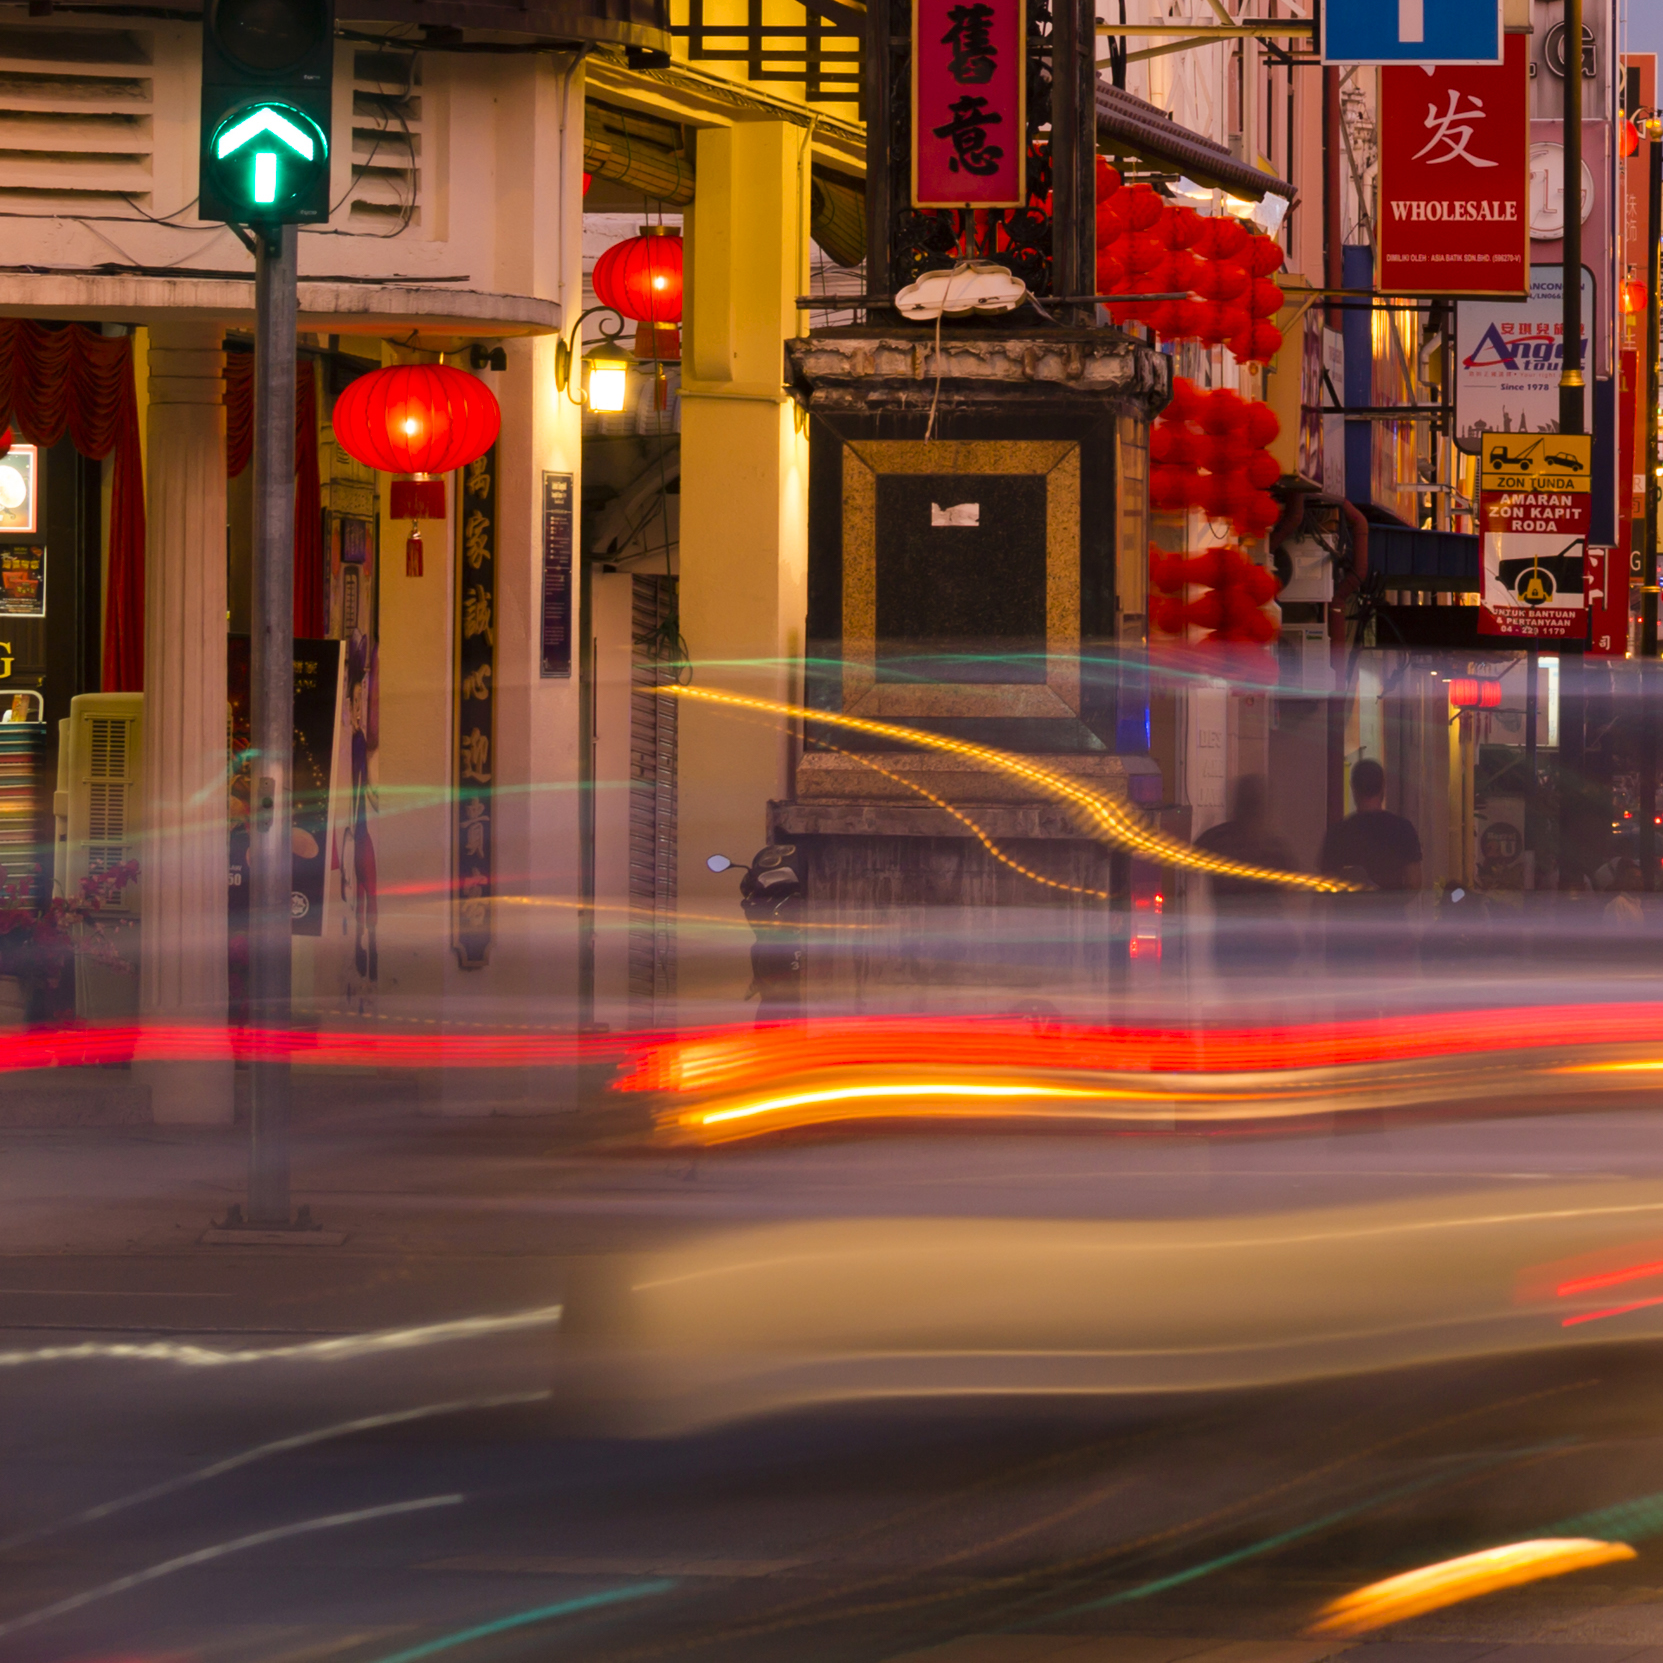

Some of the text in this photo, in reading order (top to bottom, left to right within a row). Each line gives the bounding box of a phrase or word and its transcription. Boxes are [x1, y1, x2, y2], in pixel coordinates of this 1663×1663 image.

[1389, 199, 1518, 222] WHOLESALE
[1431, 254, 1445, 263] ASIA
[1446, 254, 1463, 263] BATIK
[1500, 383, 1550, 391] Since 1978
[1497, 477, 1575, 489] ZON TUNDA
[1500, 493, 1573, 506] AMARAN
[1489, 506, 1582, 520] ZON KAPIT
[1511, 519, 1558, 532] RODA
[1528, 609, 1576, 619] BANTUAN
[1506, 618, 1571, 627] PERTANYAAN
